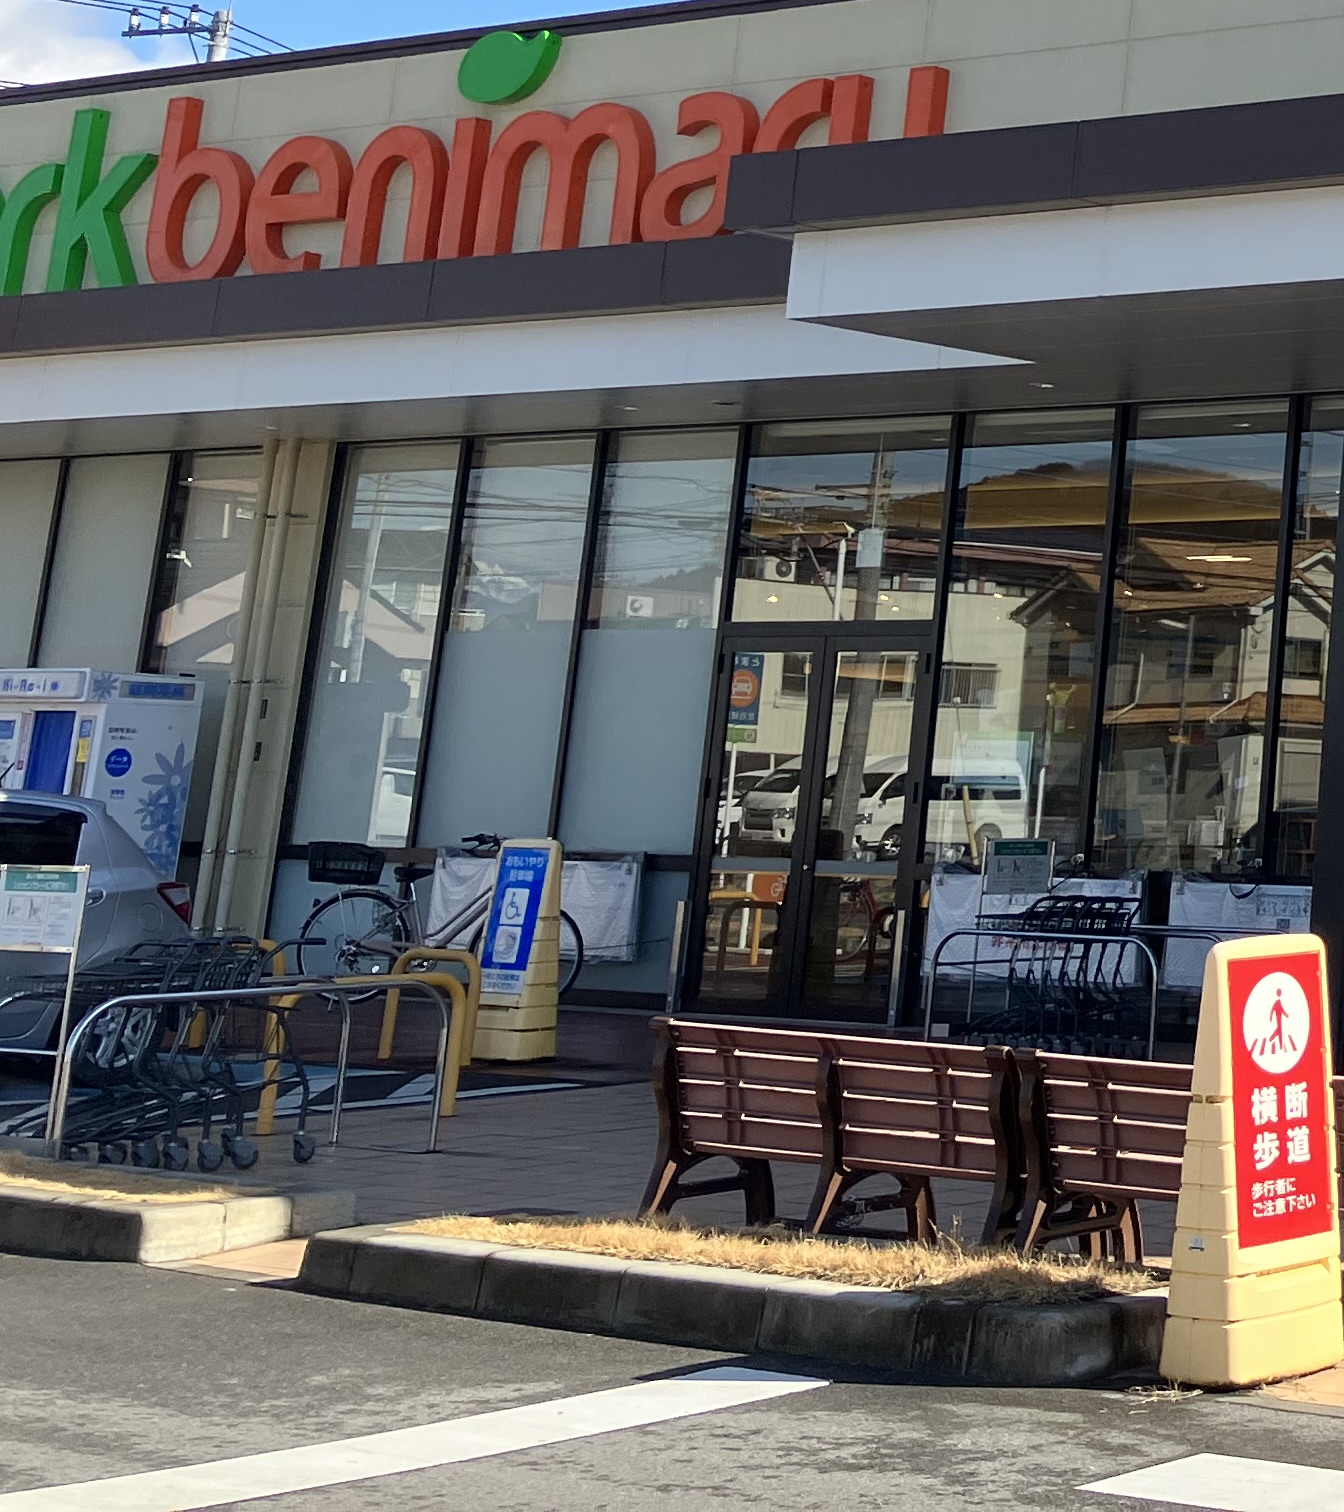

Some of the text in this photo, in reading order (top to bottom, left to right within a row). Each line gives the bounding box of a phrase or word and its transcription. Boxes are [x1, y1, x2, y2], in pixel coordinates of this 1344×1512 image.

[1251, 1081, 1309, 1127] 横断
[1253, 1125, 1311, 1171] 歩道
[1251, 1177, 1297, 1199] 歩行者に
[1252, 1193, 1316, 1218] ご注意下さい
